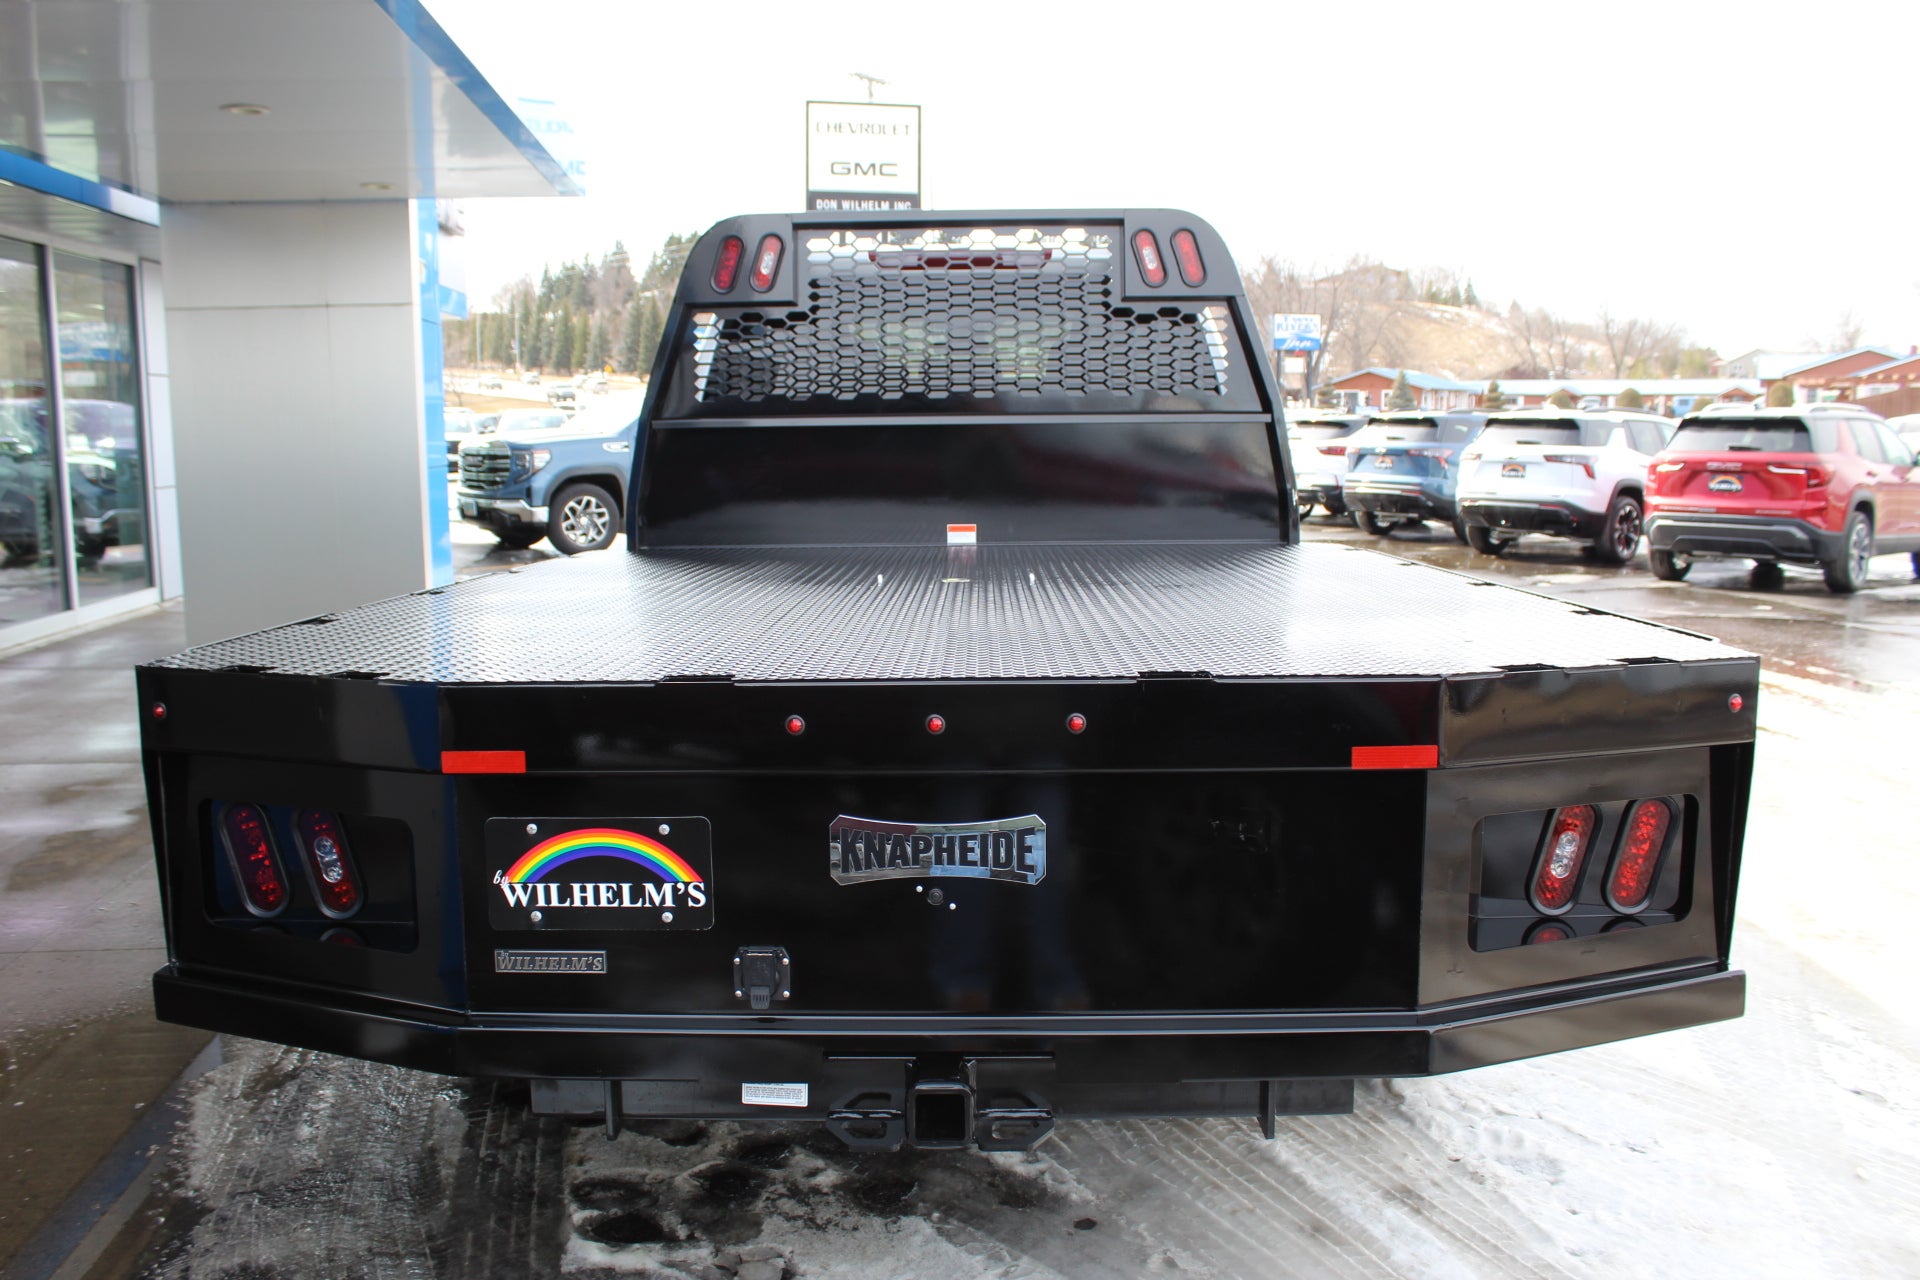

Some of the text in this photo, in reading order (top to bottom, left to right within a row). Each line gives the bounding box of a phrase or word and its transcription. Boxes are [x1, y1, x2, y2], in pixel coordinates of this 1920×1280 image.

[816, 121, 910, 135] CHEVROLET
[830, 161, 898, 176] GMC
[816, 199, 837, 210] DON
[841, 200, 889, 211] WILHELM
[839, 827, 1036, 875] KNAPHEIDE
[493, 869, 509, 889] by
[500, 881, 707, 908] WILHELM'S
[497, 956, 604, 971] WILHELM'S
